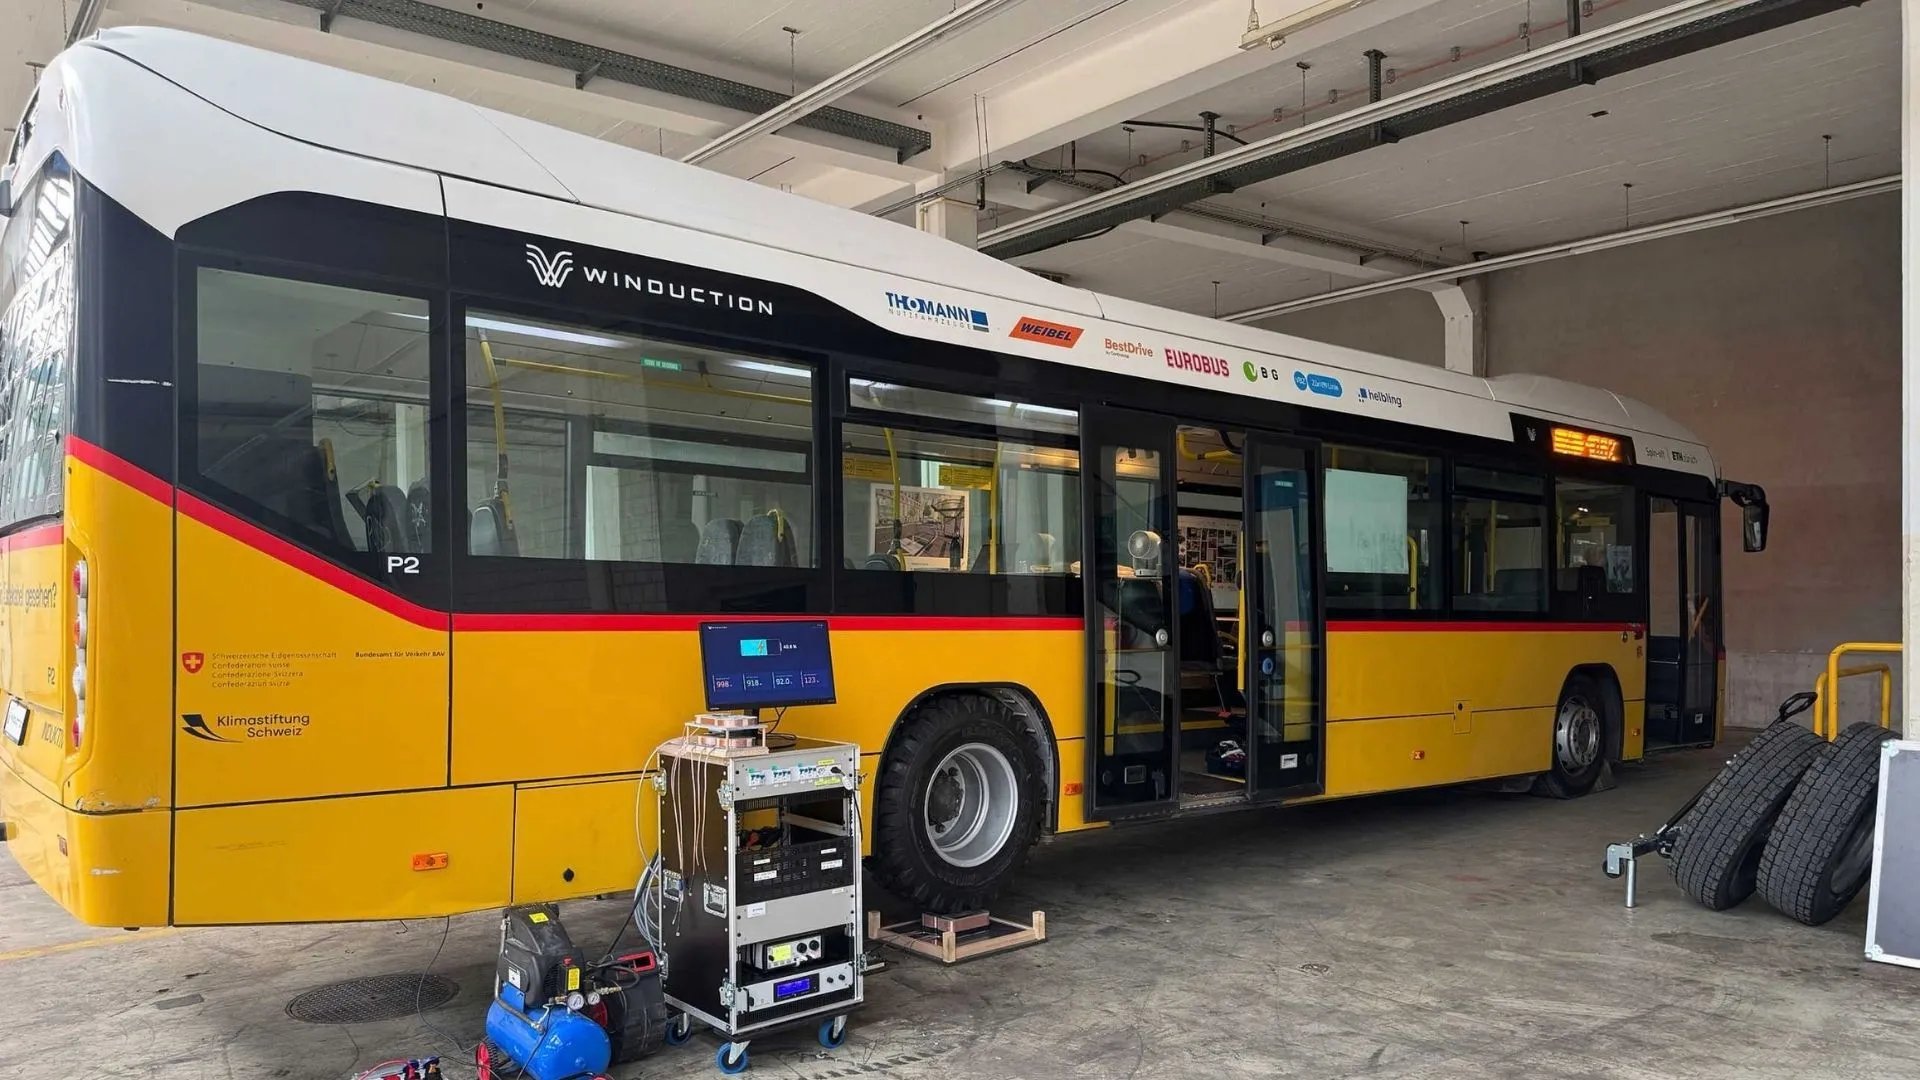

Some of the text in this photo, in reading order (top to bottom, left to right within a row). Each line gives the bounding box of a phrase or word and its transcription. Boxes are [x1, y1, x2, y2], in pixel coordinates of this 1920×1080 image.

[583, 266, 773, 316] WINDUCTION
[885, 292, 969, 322] THOMANN
[1020, 322, 1072, 341] WEIBEL
[1104, 338, 1153, 357] BestDrive
[1164, 348, 1230, 377] EUROBUS
[1368, 389, 1402, 408] helbling
[387, 556, 420, 574] P2
[217, 714, 310, 727] Klimastiftung
[247, 726, 302, 738] Schweiz
